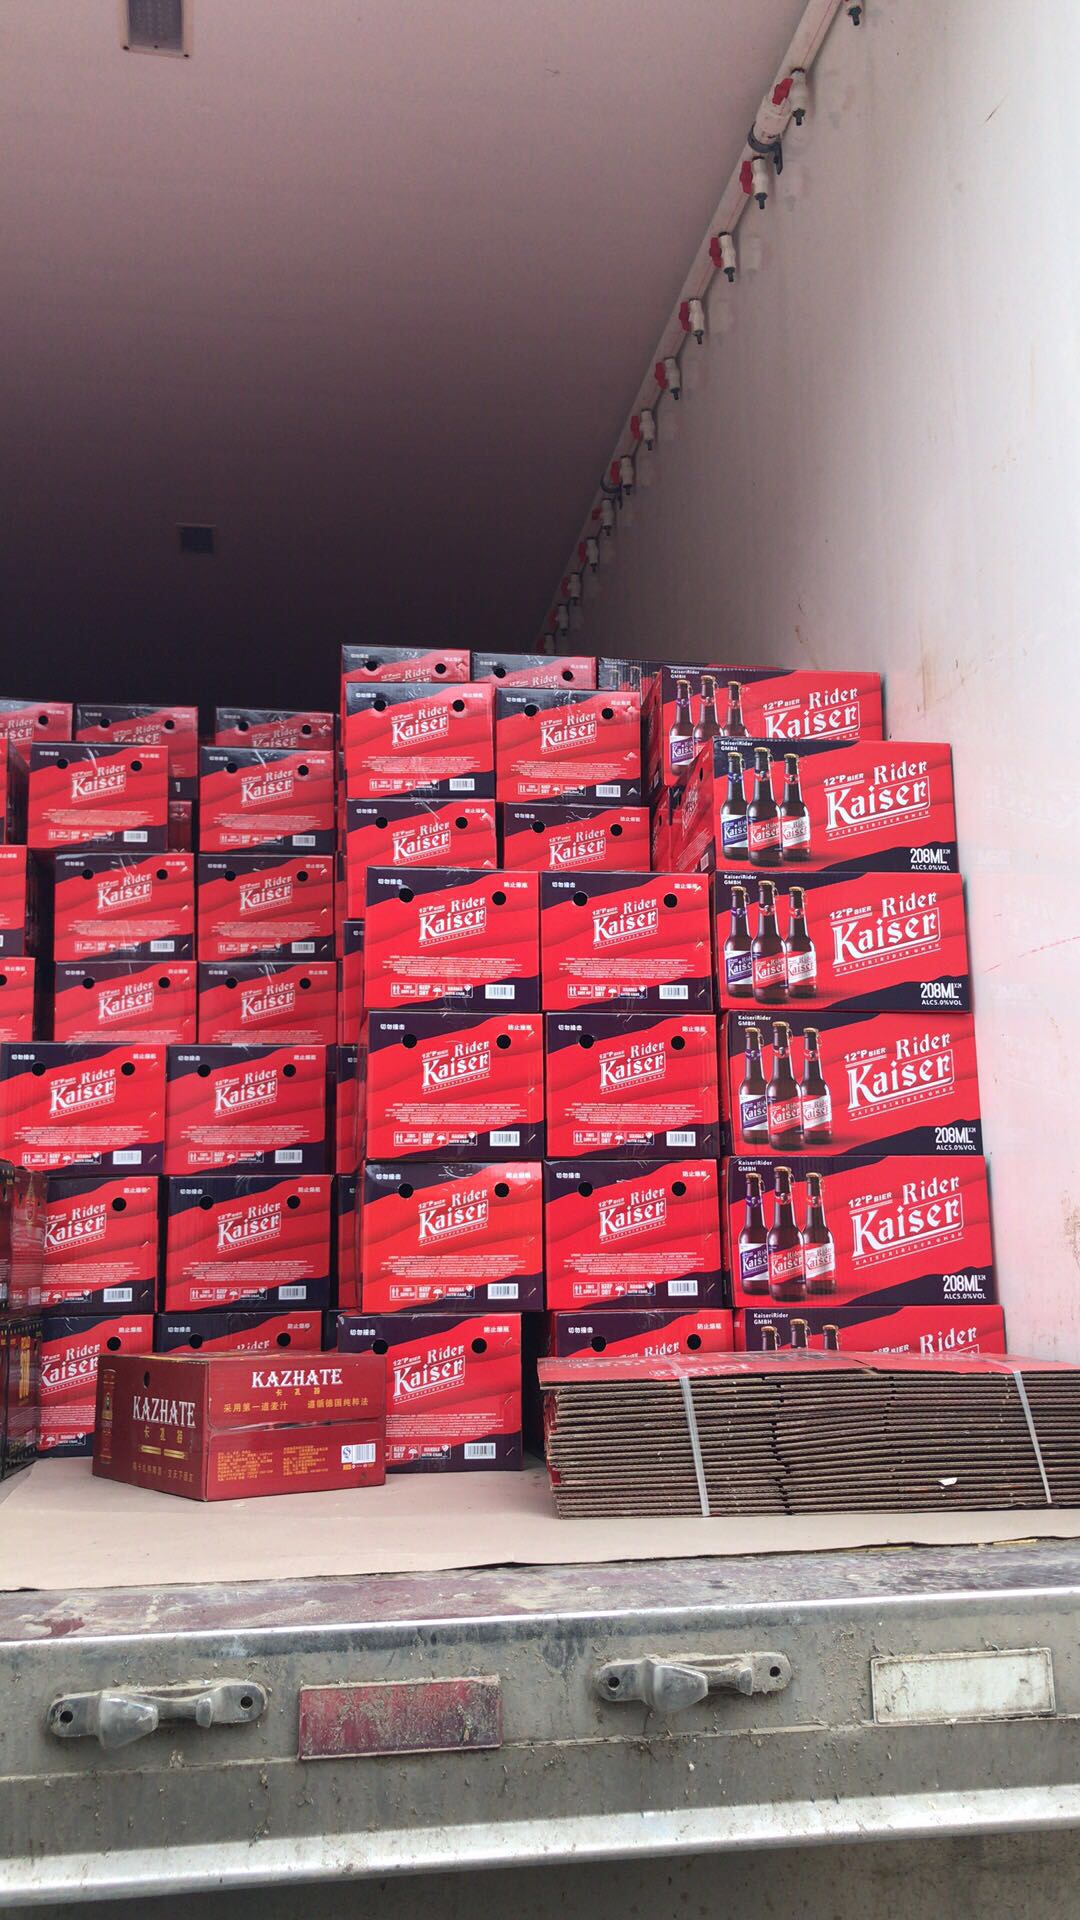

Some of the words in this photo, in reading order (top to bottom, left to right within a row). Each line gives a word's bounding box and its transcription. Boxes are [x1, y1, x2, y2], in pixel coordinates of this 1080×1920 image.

[784, 698, 801, 707] BIER
[809, 688, 858, 710] Rider
[418, 706, 448, 720] Rider
[567, 713, 596, 725] Rider
[765, 707, 858, 740] Kaiser
[392, 716, 448, 743] Kaiser
[541, 722, 595, 748] Kaiser
[98, 764, 126, 776] Rider
[265, 770, 292, 782] Rider
[847, 773, 865, 782] BIER
[874, 760, 927, 785] Rider
[71, 773, 125, 797] Kaiser
[241, 779, 292, 802] Kaiser
[825, 782, 928, 830] Kaiser
[420, 822, 450, 836] Rider
[576, 829, 605, 842] Rider
[393, 832, 450, 860] Kaiser
[549, 839, 605, 865] Kaiser
[910, 848, 948, 864] 208ML
[124, 873, 153, 886] Rider
[264, 876, 291, 888] Rider
[97, 882, 152, 908] Kaiser
[240, 885, 291, 910] Kaiser
[451, 897, 486, 912] Rider
[882, 892, 937, 918] Rider
[624, 898, 657, 914] Rider
[854, 905, 872, 915] BIER
[419, 909, 485, 940] Kaiser
[593, 910, 657, 942] Kaiser
[832, 914, 938, 965] Kaiser
[125, 981, 155, 995] Rider
[267, 982, 296, 995] Rider
[920, 982, 959, 999] 208ML
[98, 991, 153, 1018] Kaiser
[241, 991, 295, 1017] Kaiser
[454, 1040, 490, 1057] Rider
[631, 1042, 665, 1058] Rider
[868, 1047, 887, 1057] BIER
[896, 1033, 951, 1060] Rider
[82, 1068, 116, 1084] Rider
[245, 1069, 277, 1084] Rider
[422, 1053, 489, 1087] Kaiser
[600, 1054, 664, 1087] Kaiser
[847, 1055, 952, 1109] Kaiser
[50, 1080, 114, 1111] Kaiser
[214, 1080, 276, 1111] Kaiser
[935, 1127, 973, 1143] 208ML
[452, 1189, 488, 1207] Rider
[631, 1187, 665, 1205] Rider
[874, 1192, 893, 1202] BIER
[903, 1177, 960, 1205] Rider
[72, 1203, 106, 1220] Rider
[248, 1202, 281, 1219] Rider
[419, 1202, 487, 1239] Kaiser
[599, 1201, 665, 1236] Kaiser
[217, 1214, 280, 1246] Kaiser
[851, 1200, 961, 1257] Kaiser
[942, 1274, 983, 1292] 208ML
[920, 1327, 977, 1353] Rider
[66, 1343, 100, 1361] Rider
[427, 1345, 465, 1364] Rider
[252, 1368, 343, 1388] KAZHATE
[393, 1359, 464, 1397] Kaiser
[132, 1396, 196, 1428] KAZHATE
